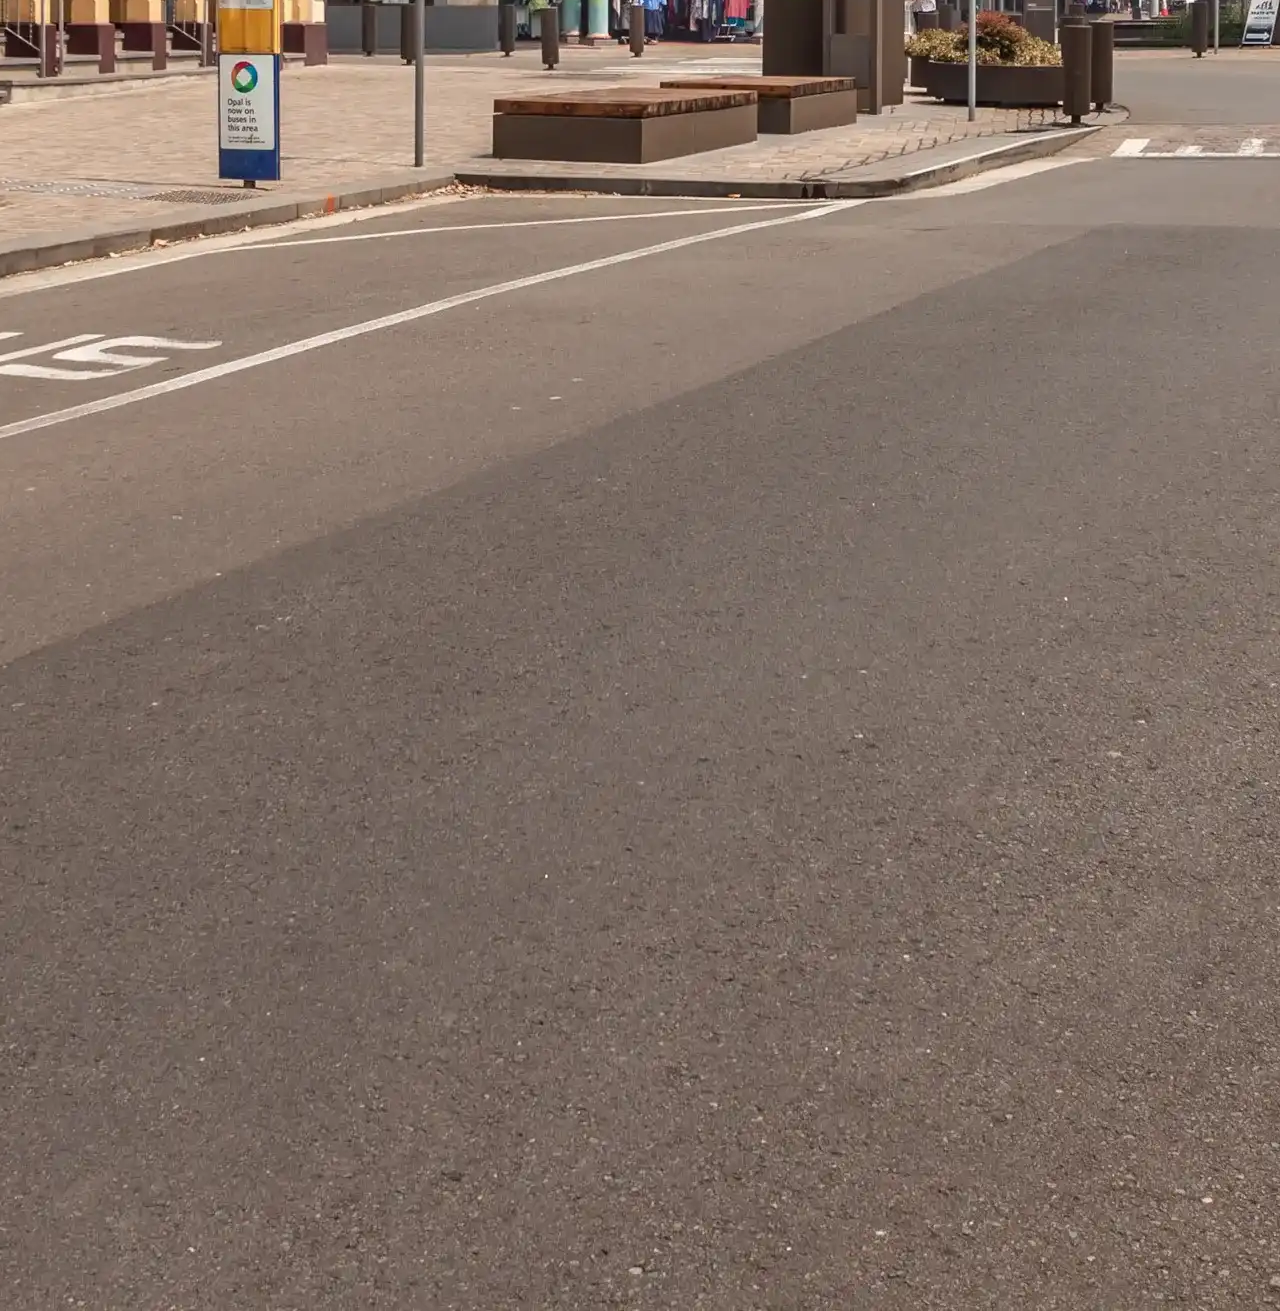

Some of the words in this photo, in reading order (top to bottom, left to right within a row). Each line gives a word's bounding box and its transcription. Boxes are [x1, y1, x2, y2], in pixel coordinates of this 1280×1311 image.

[227, 98, 243, 107] Opal
[245, 98, 252, 106] is
[227, 115, 247, 123] buses
[249, 115, 257, 123] in
[227, 124, 240, 132] this
